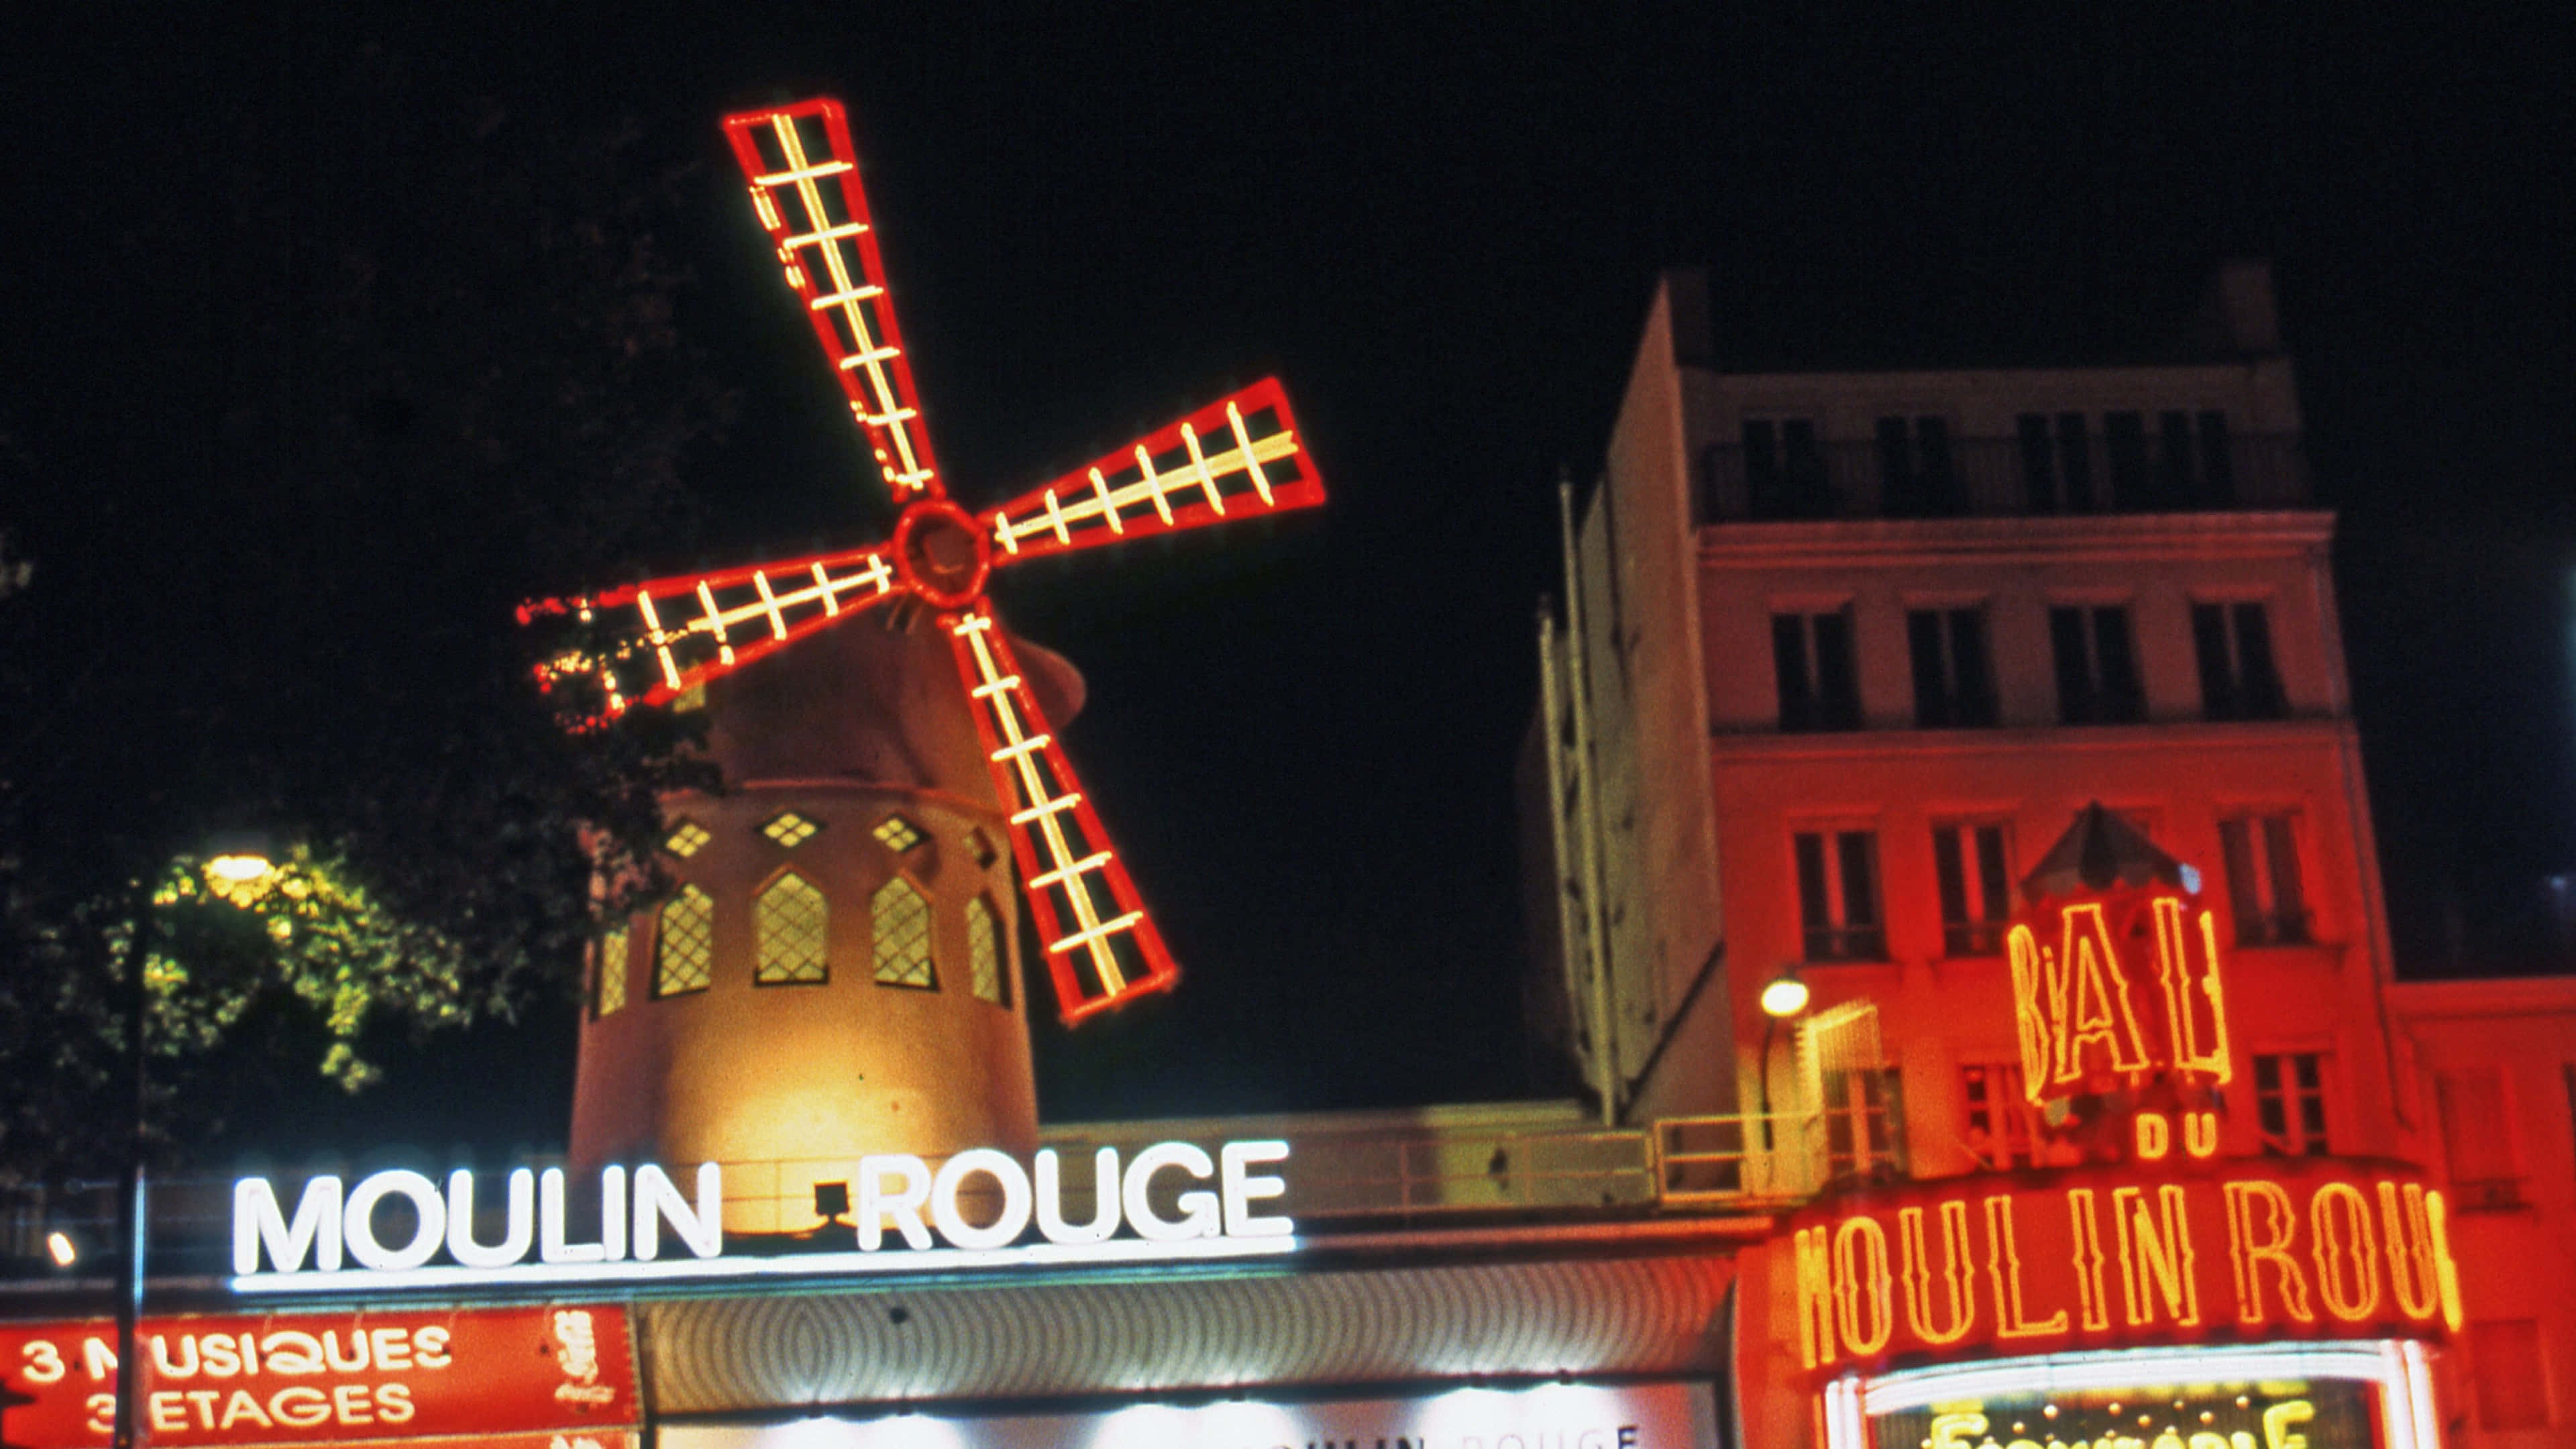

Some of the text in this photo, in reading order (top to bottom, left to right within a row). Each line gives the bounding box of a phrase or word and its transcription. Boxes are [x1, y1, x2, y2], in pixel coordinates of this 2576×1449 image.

[2007, 896, 2233, 1108] BAL
[2135, 1112, 2218, 1160] DU
[231, 1139, 1299, 1275] MOULIN ROUGE
[1793, 1179, 2464, 1371] MOULIN ROU
[22, 1326, 453, 1383] 3 MUSIQUES
[87, 1383, 415, 1433] 3 ETAGES
